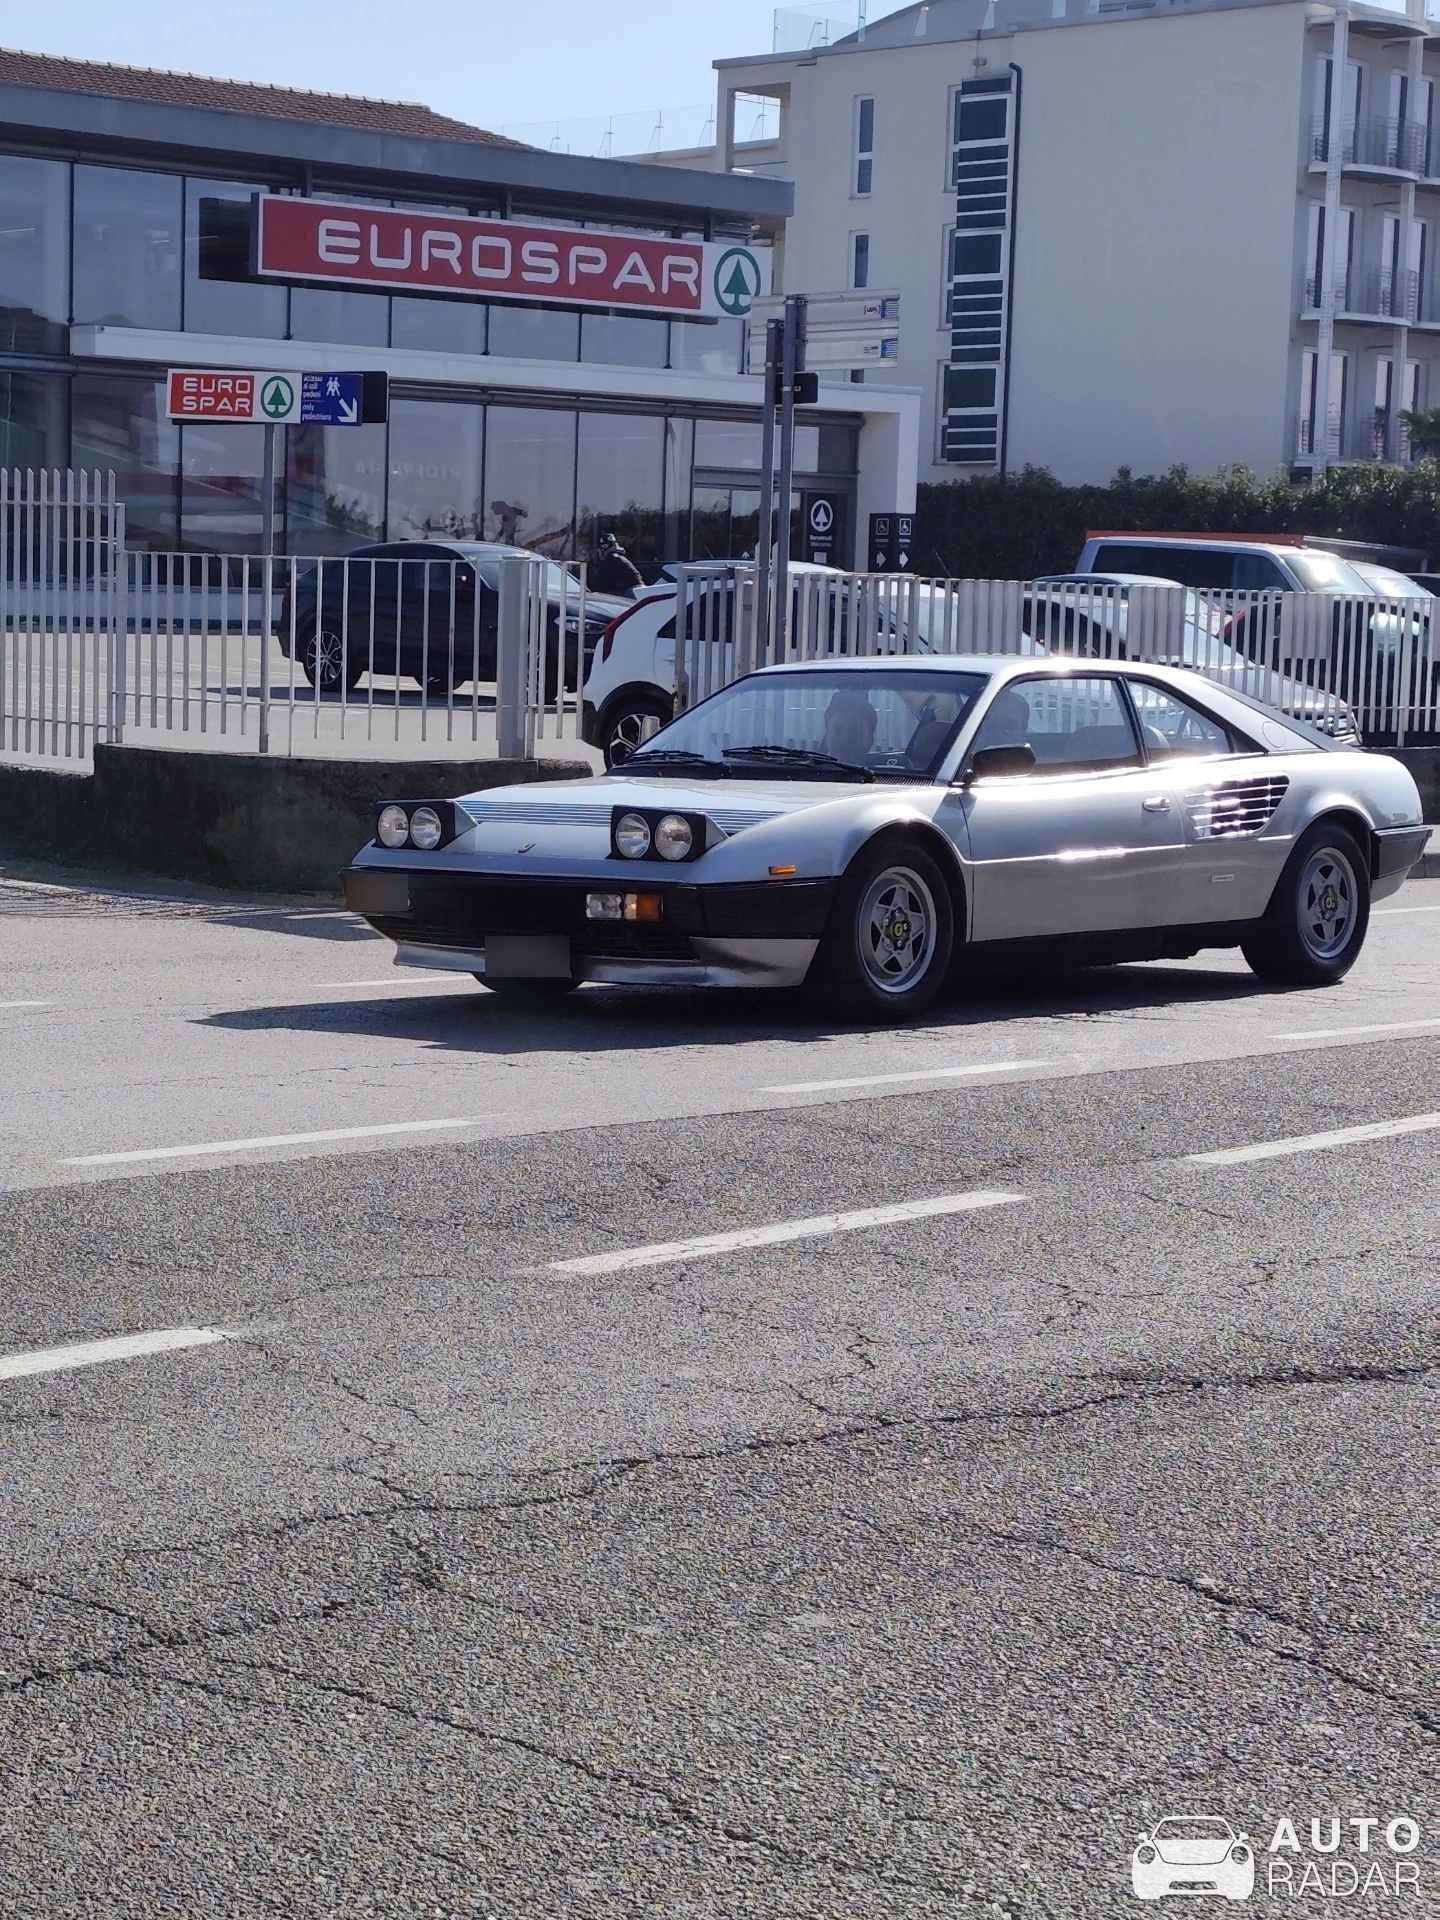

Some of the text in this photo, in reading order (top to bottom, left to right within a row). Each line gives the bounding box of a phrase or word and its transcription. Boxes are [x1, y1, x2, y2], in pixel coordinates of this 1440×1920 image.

[318, 218, 699, 297] EUROSPAR
[183, 377, 251, 395] EURO
[182, 395, 251, 414] SPAR
[302, 403, 315, 412] only
